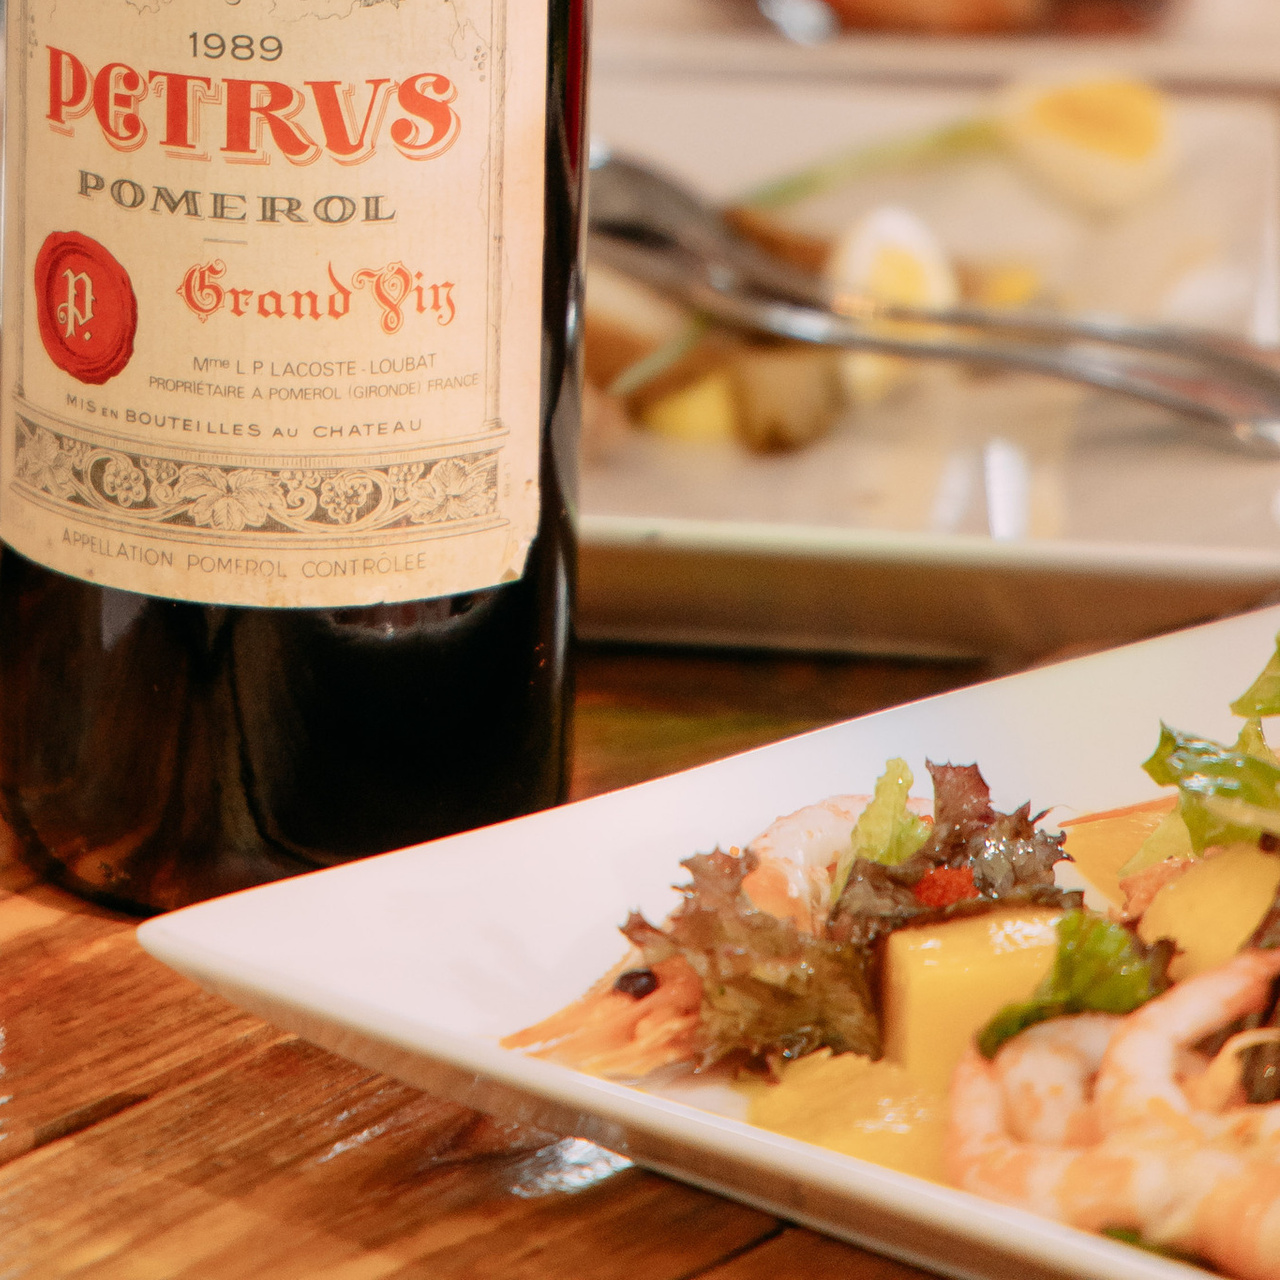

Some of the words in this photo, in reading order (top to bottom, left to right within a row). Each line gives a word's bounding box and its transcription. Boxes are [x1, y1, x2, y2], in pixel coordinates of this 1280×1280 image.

[189, 32, 284, 62] 1989
[45, 44, 462, 167] PETRVS
[77, 169, 397, 226] POMEROL
[176, 258, 353, 324] Grand
[351, 260, 456, 335] Vin
[148, 376, 246, 400] PROPRIÉTAIRE
[251, 387, 264, 400] A
[269, 386, 342, 402] POMEROL
[348, 381, 422, 400] (GIRONDE)
[427, 372, 480, 393] FRANCE
[193, 356, 230, 373] Mme
[271, 360, 357, 378] LACOSTE
[370, 353, 438, 375] LOUBAT
[66, 393, 97, 414] MIS
[102, 407, 119, 419] EN
[125, 409, 262, 438] BOUTEILLES
[272, 427, 299, 438] AU
[313, 418, 423, 439] CHATEAU
[62, 527, 174, 568] APPELLATION
